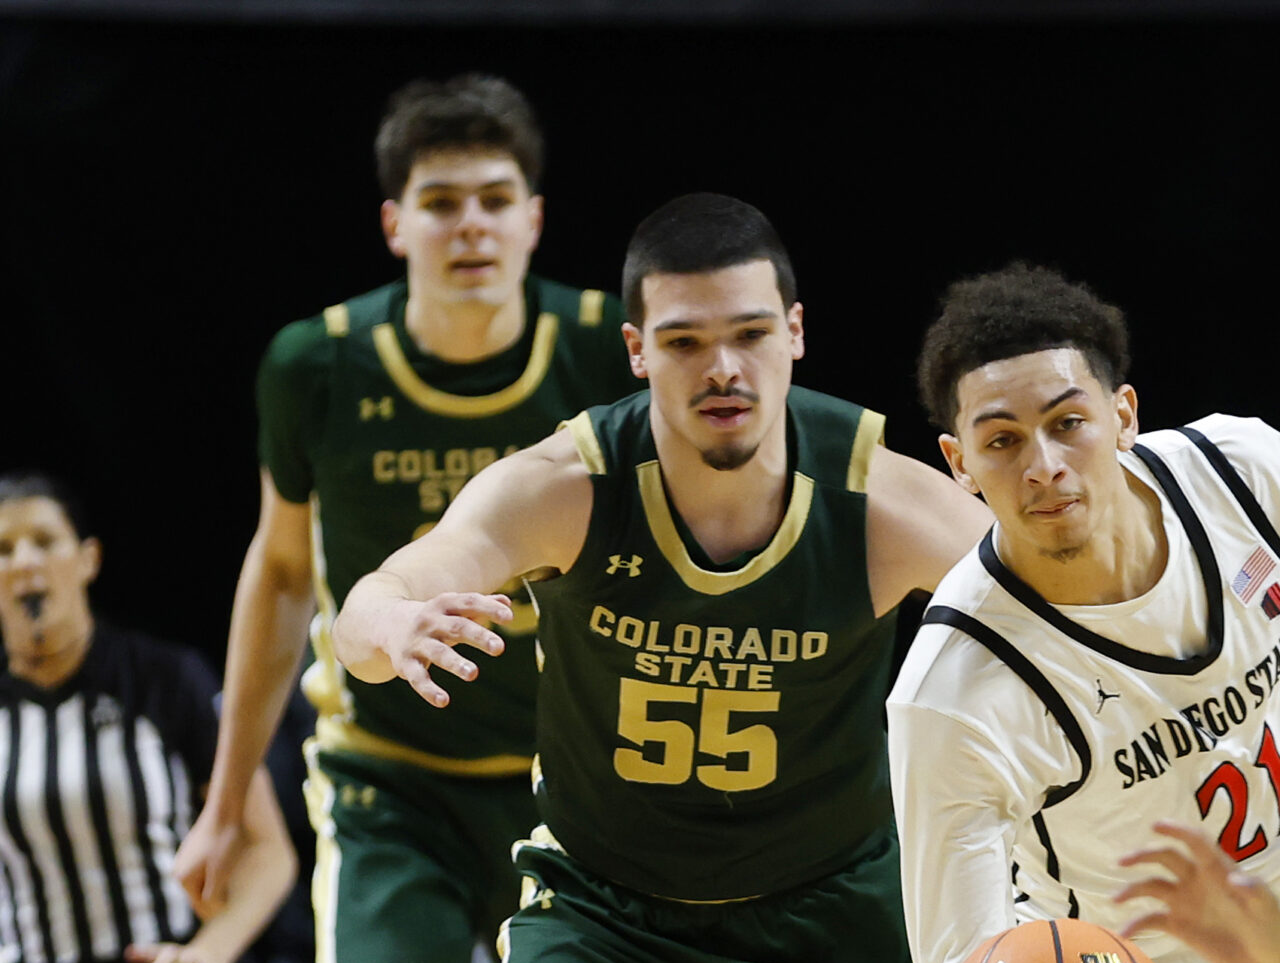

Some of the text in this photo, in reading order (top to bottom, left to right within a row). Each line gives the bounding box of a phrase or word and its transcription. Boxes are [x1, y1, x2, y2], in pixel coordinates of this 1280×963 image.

[372, 445, 518, 483] COLOR
[588, 605, 829, 663] COLORADO
[634, 651, 775, 691] STATE
[613, 676, 782, 793] 55
[1113, 723, 1172, 790] SAN
